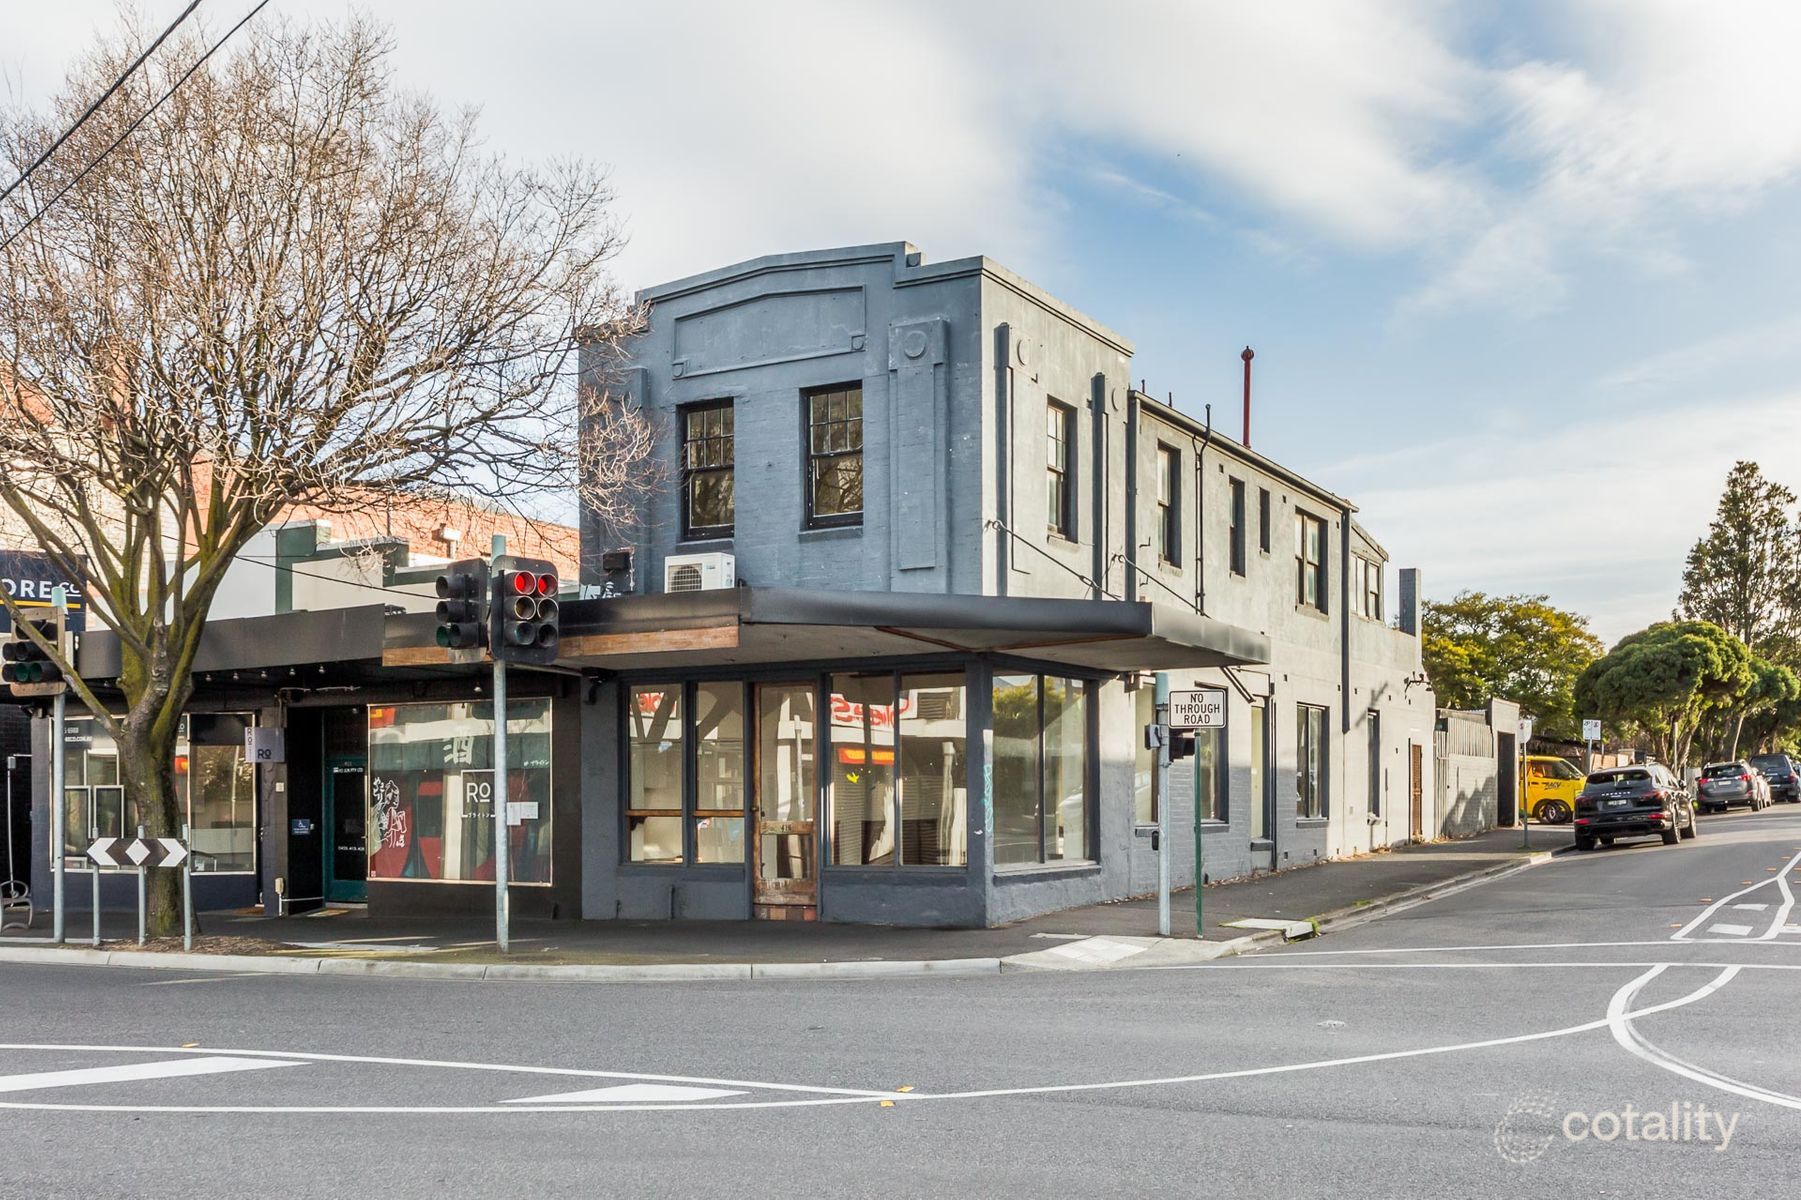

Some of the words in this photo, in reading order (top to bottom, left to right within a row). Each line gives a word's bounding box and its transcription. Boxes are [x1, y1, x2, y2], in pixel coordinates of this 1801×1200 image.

[1190, 692, 1204, 703] NO
[1174, 703, 1220, 714] THROUGH
[1183, 714, 1211, 725] ROAD
[257, 748, 272, 760] RO
[466, 782, 491, 803] RO
